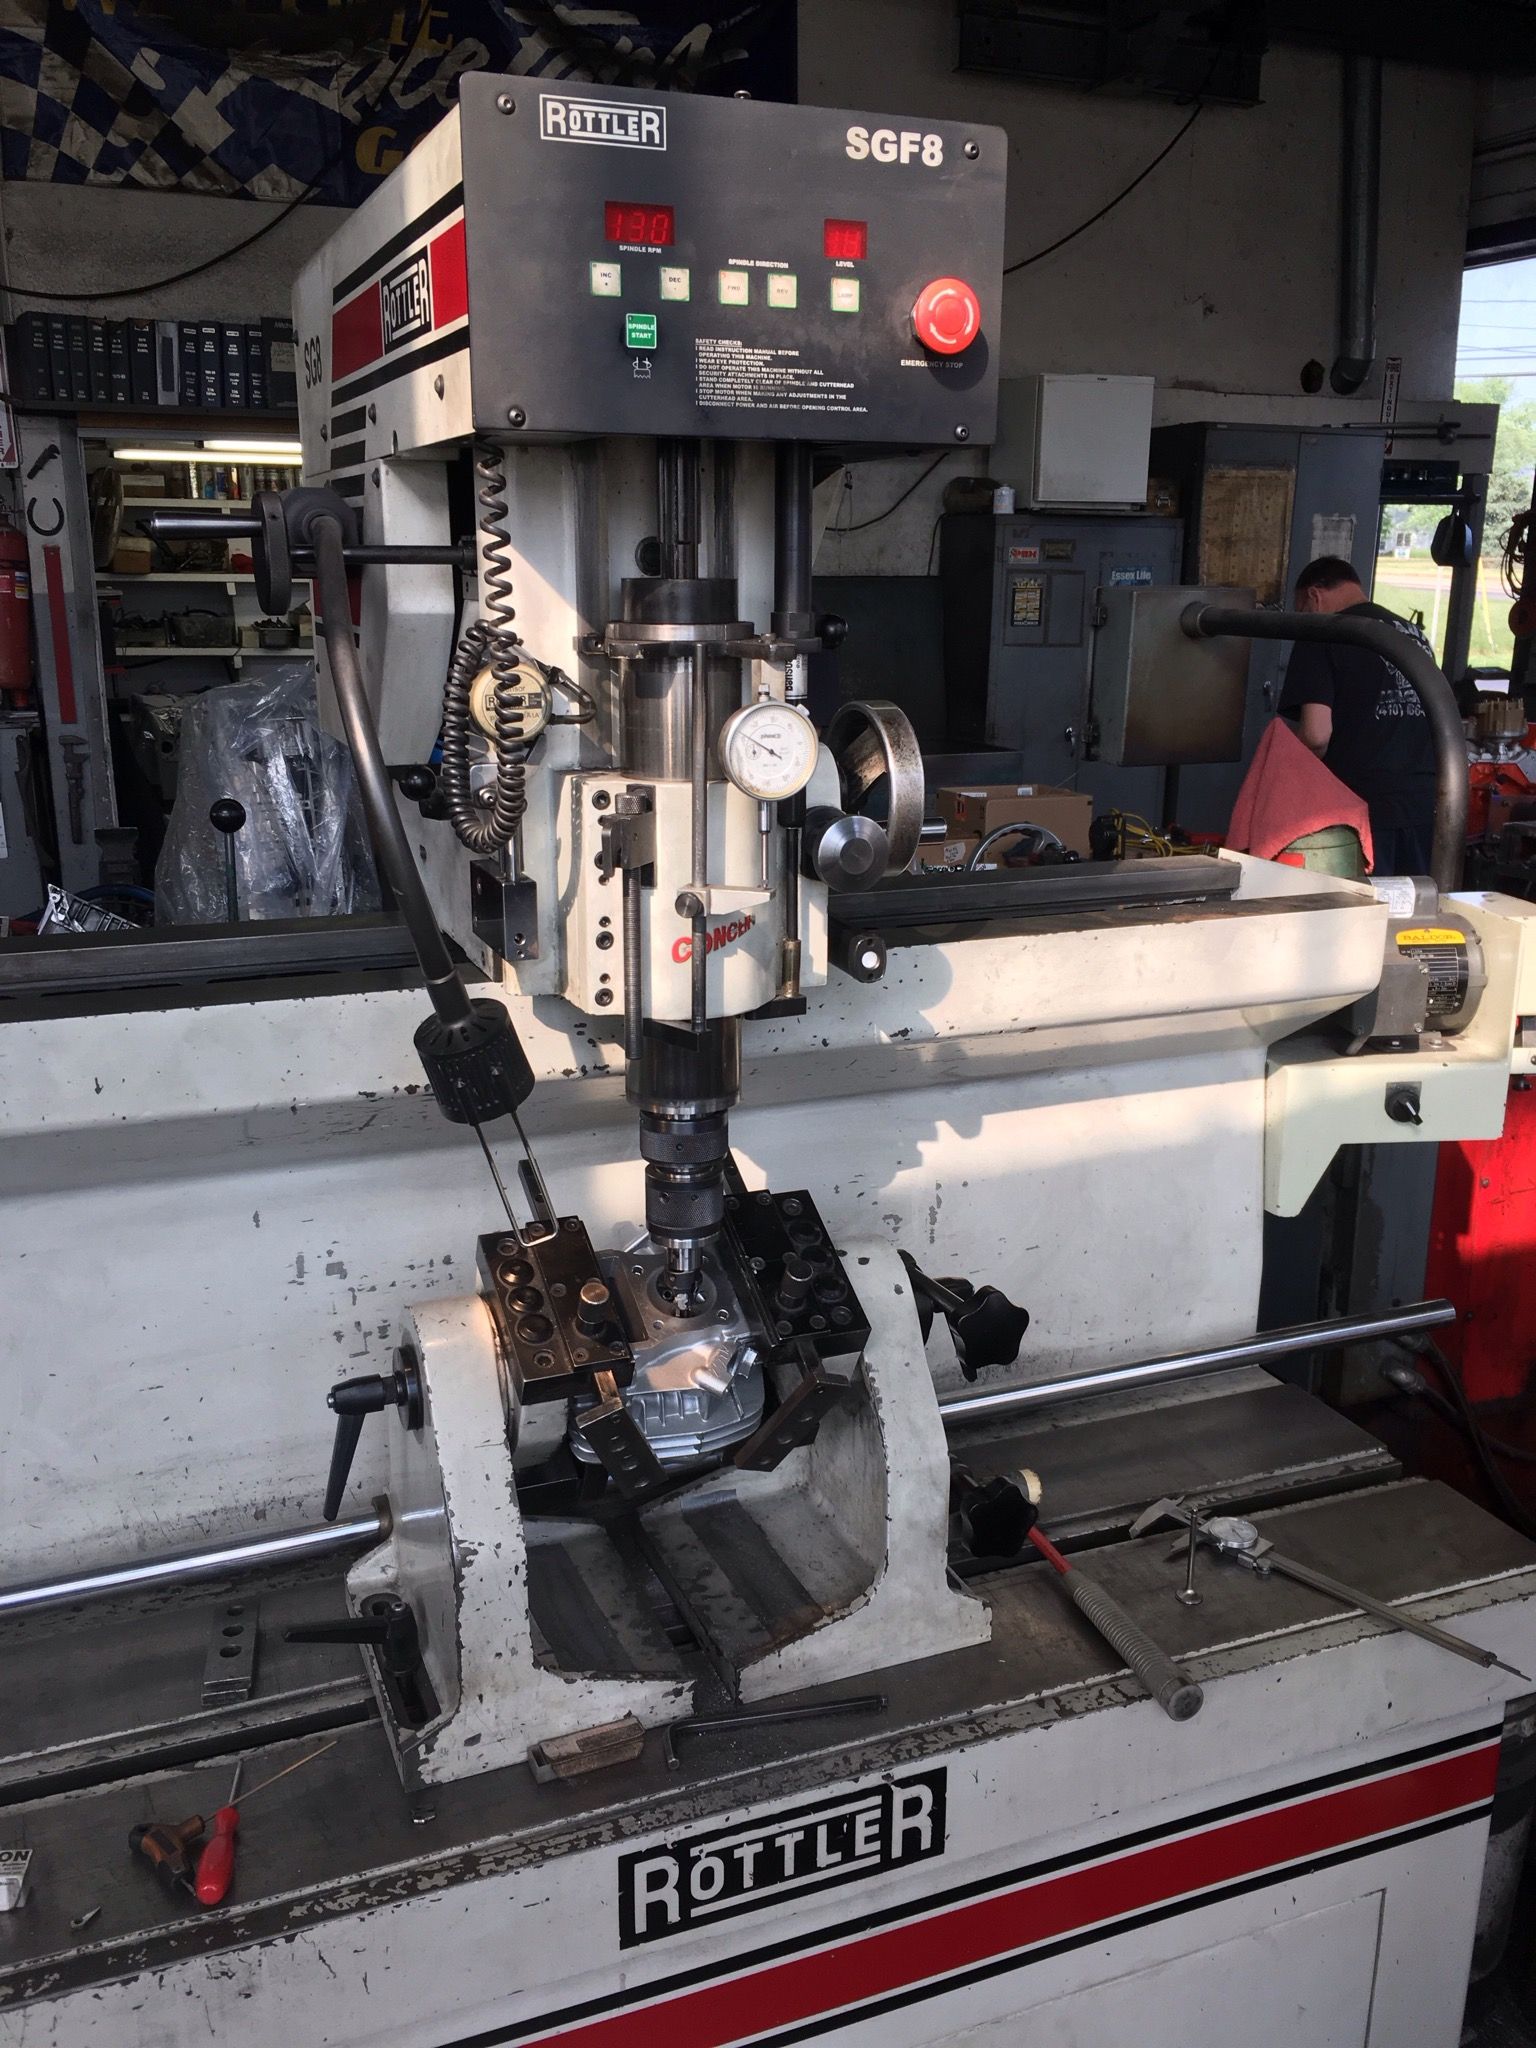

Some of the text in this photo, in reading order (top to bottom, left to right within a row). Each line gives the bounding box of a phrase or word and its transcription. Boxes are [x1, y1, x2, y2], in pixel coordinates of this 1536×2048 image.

[545, 100, 660, 144] ROTTLER
[845, 126, 943, 167] SGF8
[611, 210, 669, 244] 130
[619, 244, 647, 253] SPINDLE
[728, 258, 789, 269] SPINDLE DIRECTION
[835, 260, 855, 268] LEVEL
[600, 271, 612, 279] INC
[668, 276, 682, 284] DEC
[382, 257, 430, 346] ROTTLER
[628, 323, 656, 331] SPINDLE
[631, 331, 653, 340] START
[695, 338, 717, 346] SAFETY
[715, 346, 753, 354] INSTRUCTION
[698, 351, 731, 359] OPERATING
[304, 335, 323, 390] SG8
[901, 359, 965, 370] EMERGENCY STOP
[727, 371, 768, 379] ATTACHMENTS
[1111, 569, 1136, 582] Essex
[633, 1783, 934, 1935] ROTTLER
